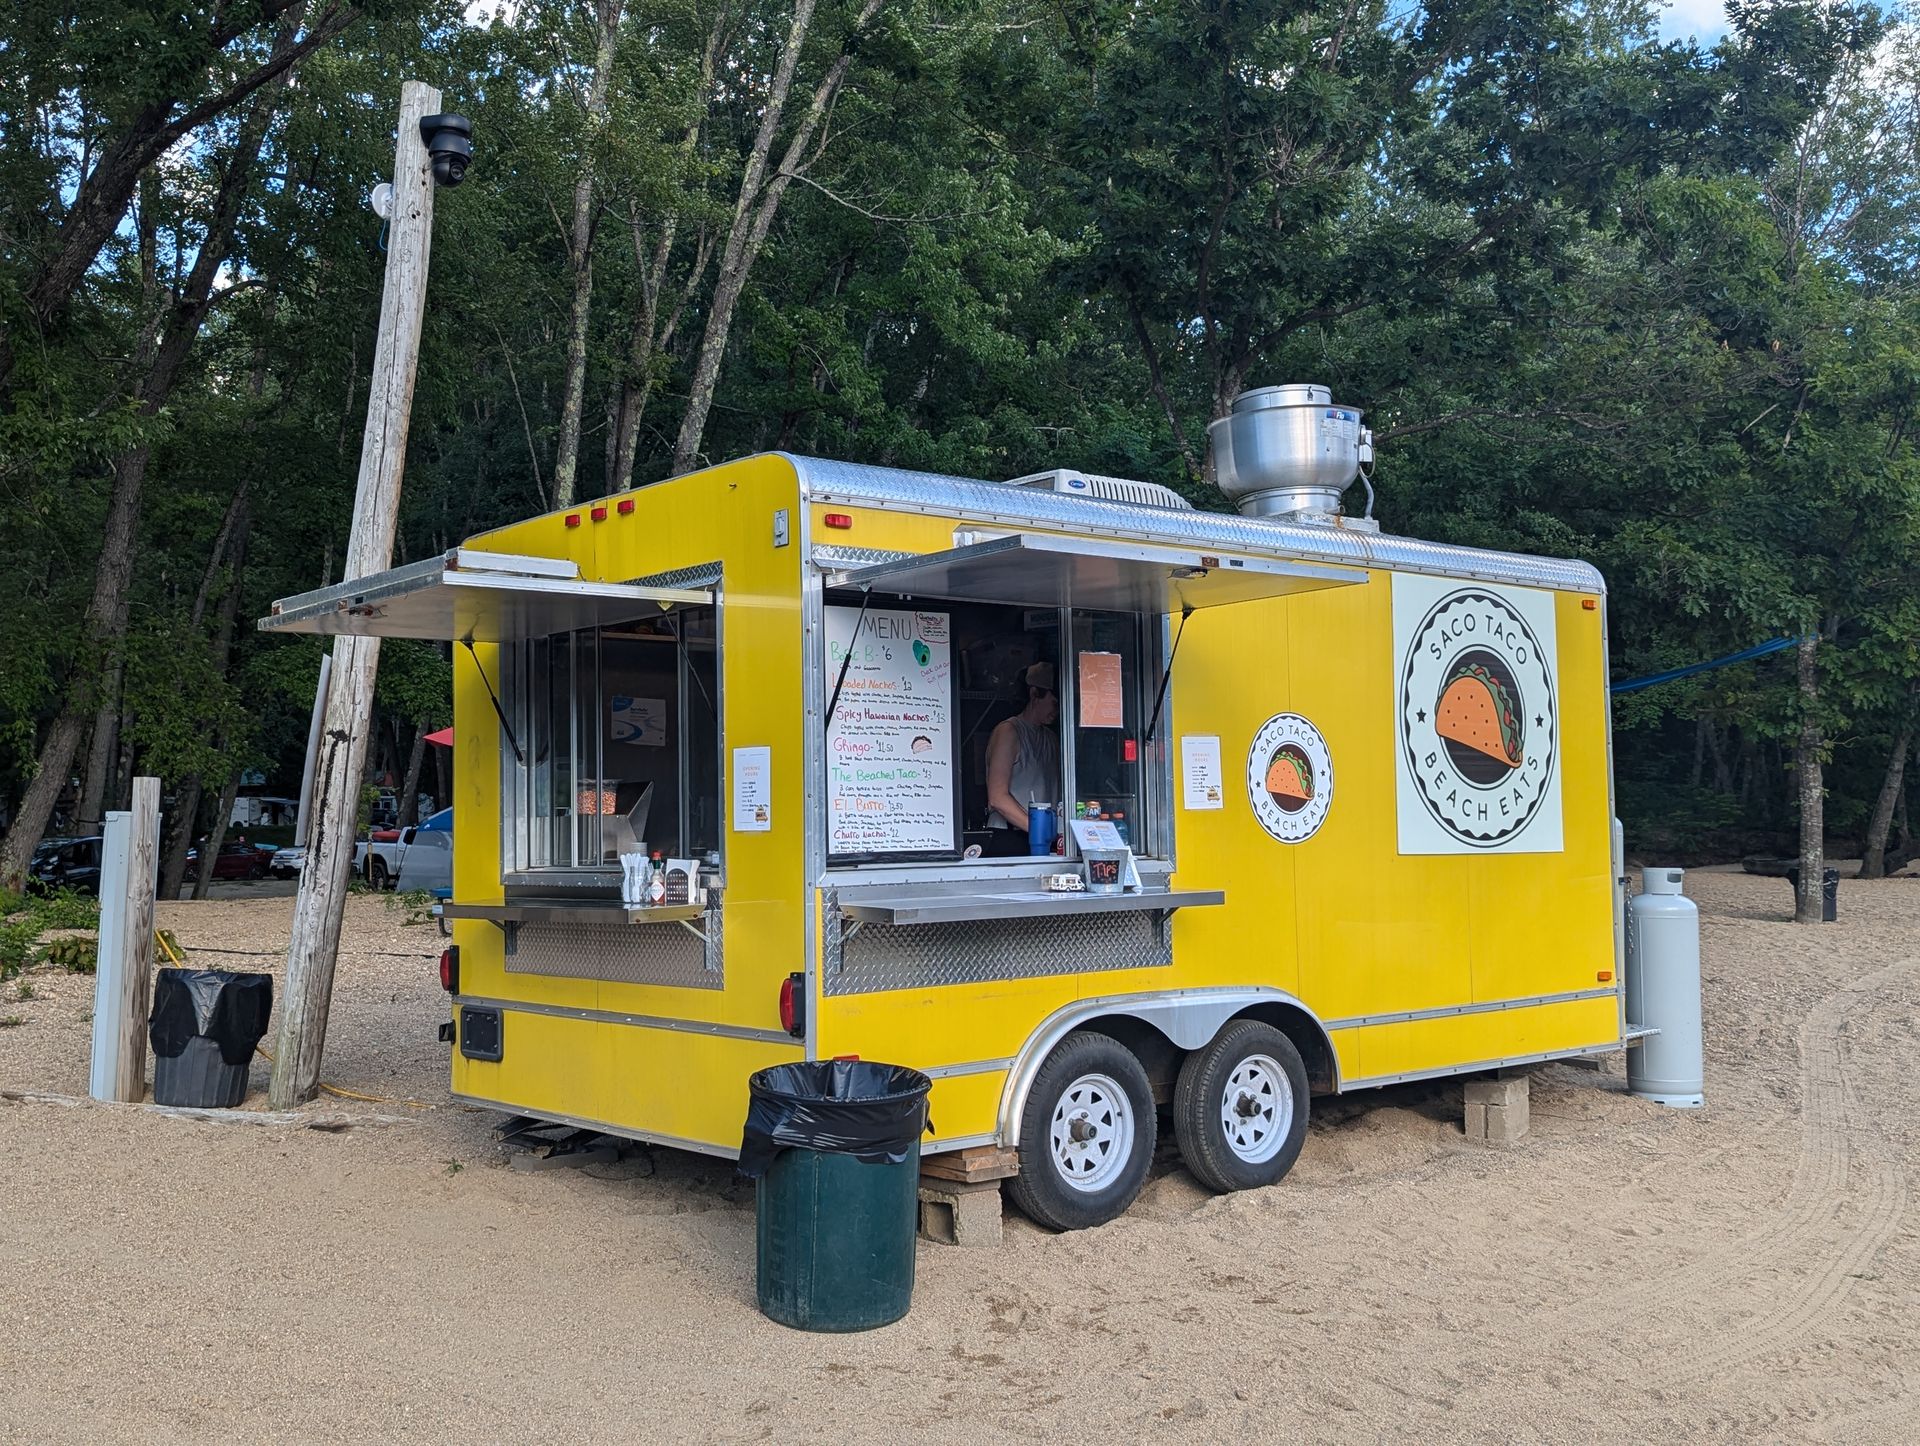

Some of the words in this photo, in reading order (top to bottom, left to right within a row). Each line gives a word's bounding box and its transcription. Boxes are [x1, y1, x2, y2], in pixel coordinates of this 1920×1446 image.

[861, 616, 912, 641] MENU
[1430, 613, 1476, 661] SACO
[1484, 614, 1527, 665] TACO
[836, 705, 862, 723] Spicy
[864, 707, 900, 721] Hawaiian
[1260, 726, 1284, 755] SACO
[1288, 725, 1315, 747] TACO
[832, 768, 852, 782] The
[856, 769, 895, 781] Beached
[1425, 752, 1488, 821] BEACH
[1499, 755, 1538, 816] EATS
[1261, 801, 1297, 830] BEACH
[1303, 791, 1324, 826] EATS
[833, 829, 860, 840] Churro
